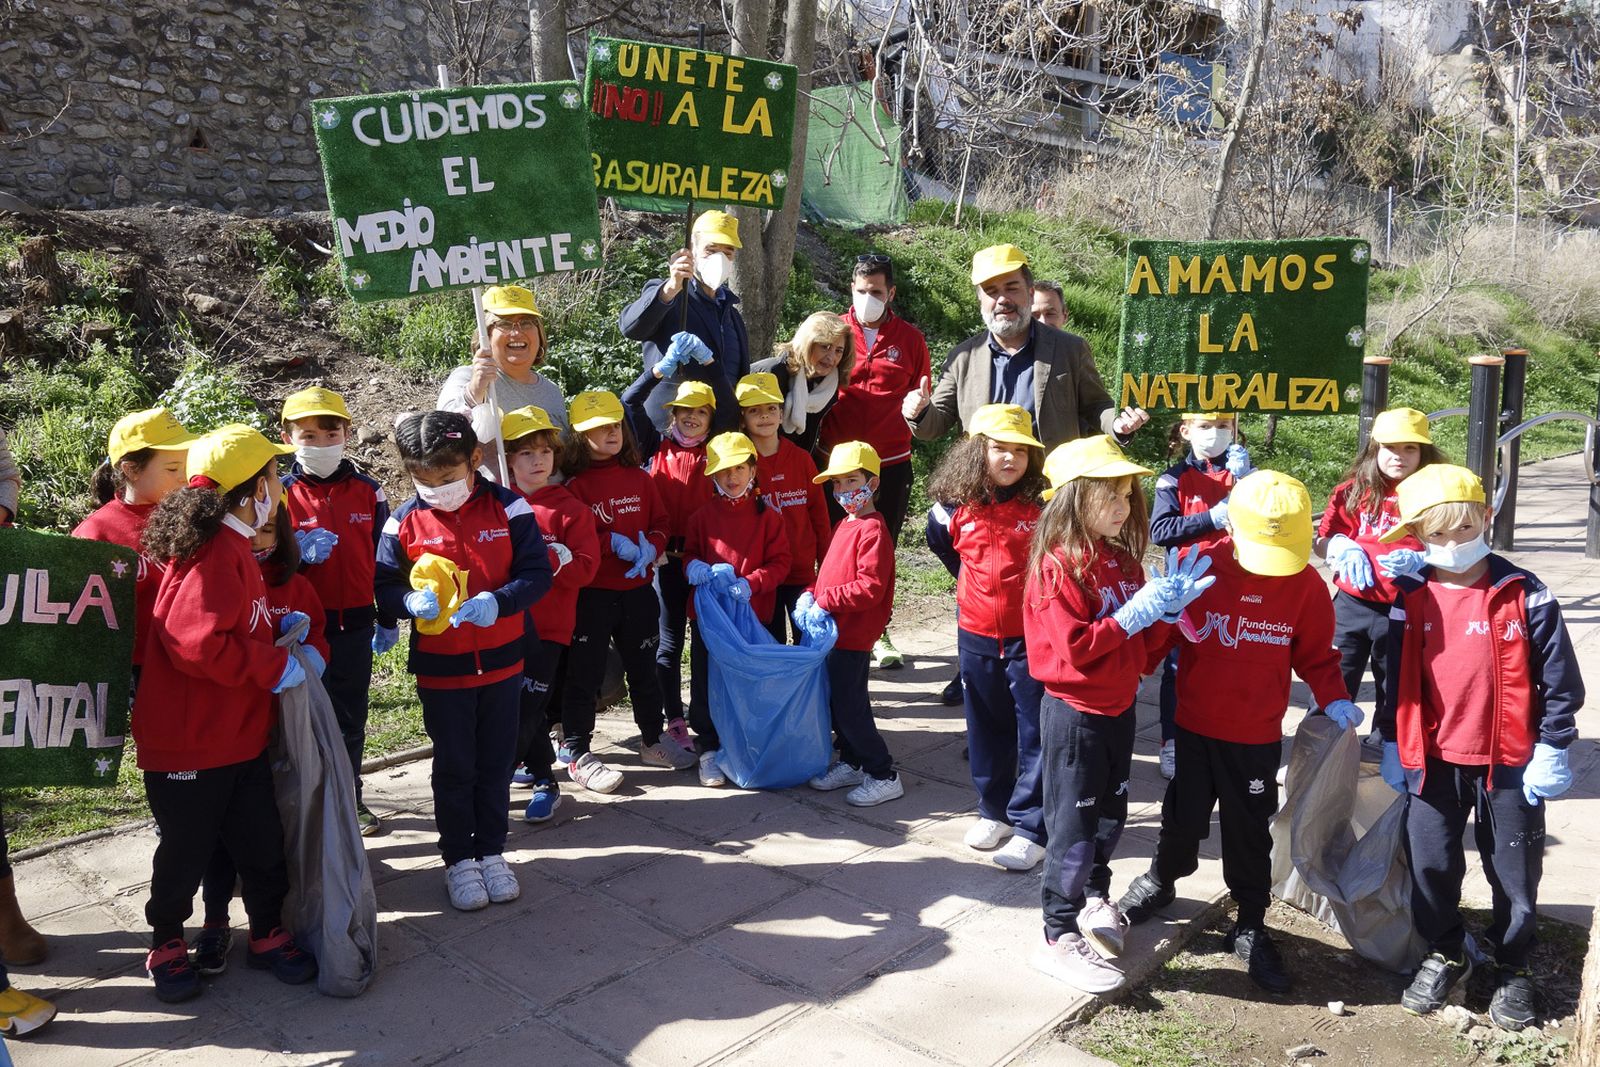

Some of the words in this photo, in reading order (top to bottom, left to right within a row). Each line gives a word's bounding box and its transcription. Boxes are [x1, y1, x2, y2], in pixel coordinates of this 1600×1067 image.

[668, 91, 699, 127] A
[722, 95, 773, 137] LA
[442, 156, 495, 195] EL
[1127, 254, 1337, 295] AMAMOS
[1198, 313, 1260, 353] LA
[1120, 372, 1340, 412] NATURALEZA
[1241, 617, 1294, 633] Fundación
